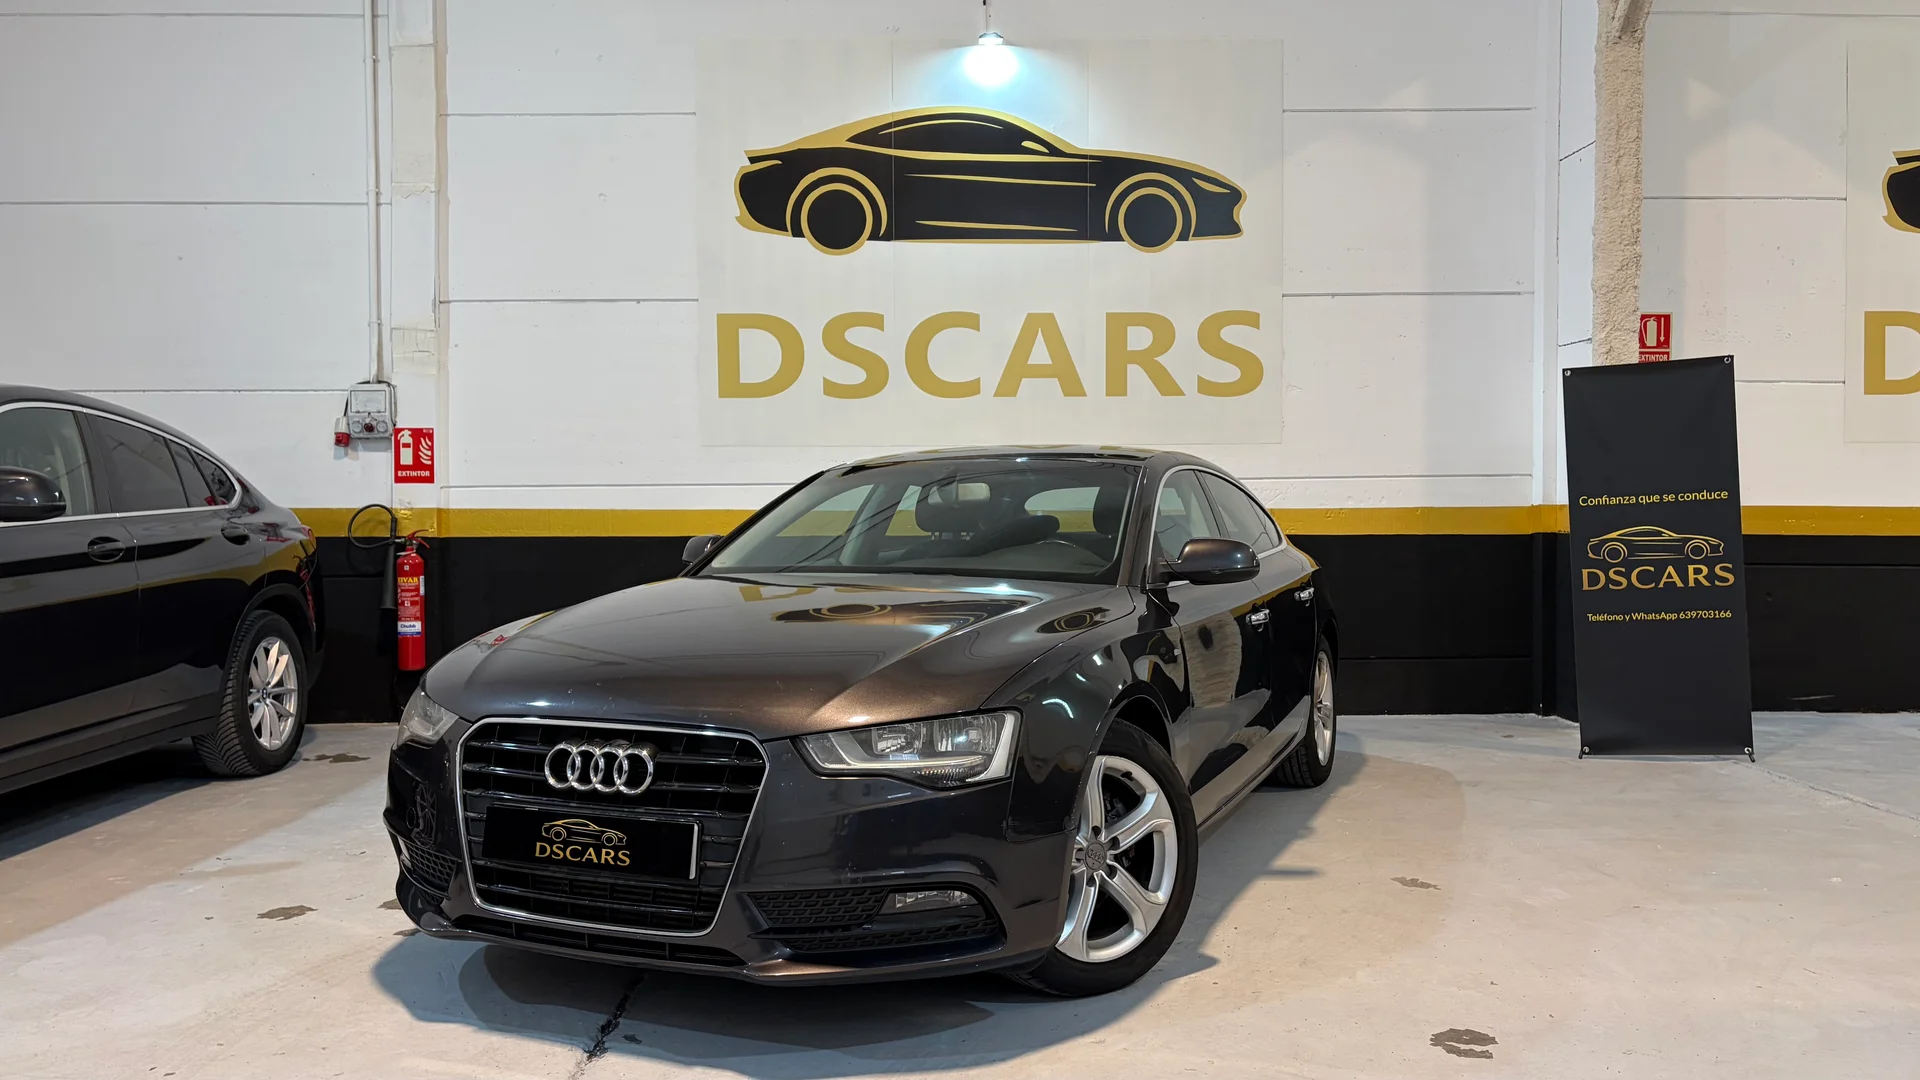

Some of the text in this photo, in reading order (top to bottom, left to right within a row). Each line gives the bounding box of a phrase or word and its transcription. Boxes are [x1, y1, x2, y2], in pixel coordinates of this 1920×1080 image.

[716, 310, 1264, 399] DSCARS
[1579, 489, 1729, 506] Confianza que se conduce
[1581, 563, 1735, 590] DSCARS
[1586, 610, 1732, 622] Teléfono y WhatsApp 639703166
[535, 842, 631, 866] DSCARS
